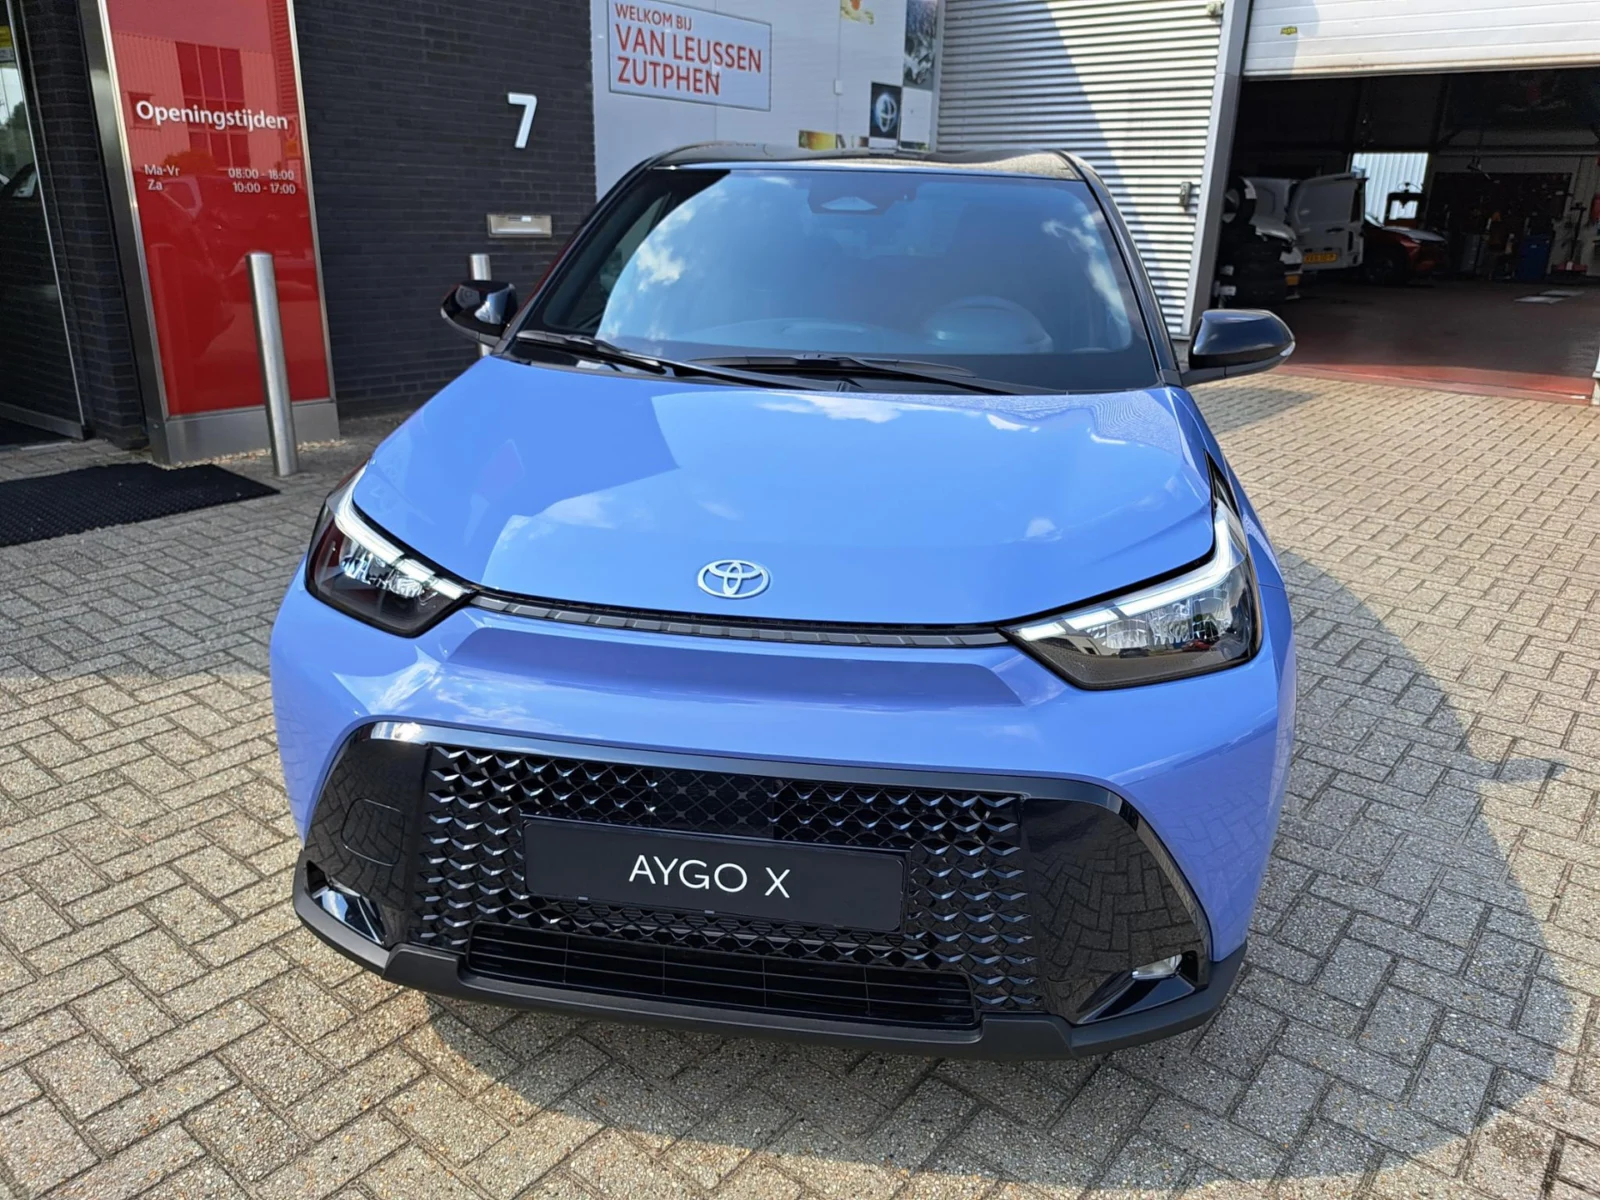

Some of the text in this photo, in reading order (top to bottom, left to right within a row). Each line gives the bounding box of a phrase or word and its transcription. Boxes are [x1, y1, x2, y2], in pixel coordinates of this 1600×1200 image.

[615, 3, 692, 31] WELKOM BIJ
[615, 24, 762, 73] VAN LEUSSEN
[617, 56, 720, 96] ZUTPHEN
[136, 100, 288, 132] Openingstijden
[508, 92, 538, 149] 7
[144, 164, 180, 177] Ma-Vr
[228, 168, 259, 180] 08:00
[268, 169, 295, 181] 18:00
[148, 179, 163, 191] Za
[233, 181, 260, 193] 10:00
[270, 182, 296, 194] 17:00
[629, 854, 790, 898] AYGO X
